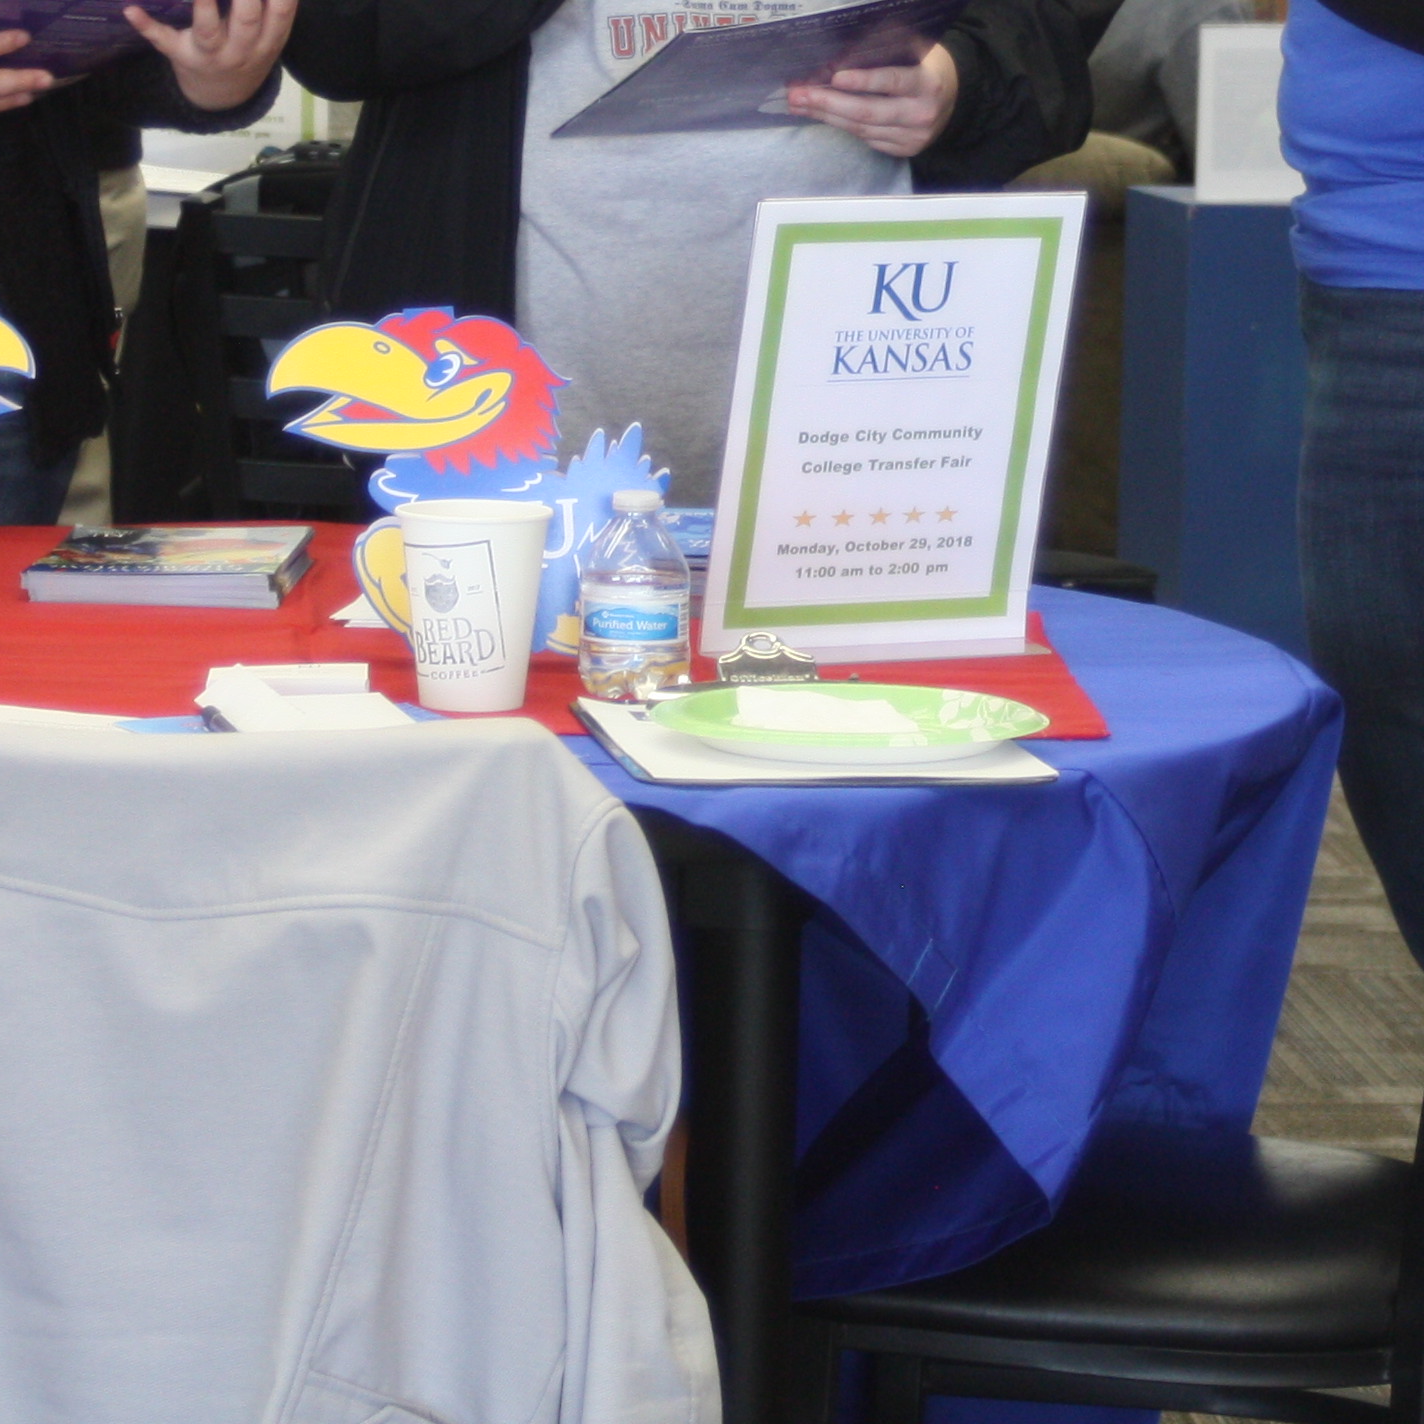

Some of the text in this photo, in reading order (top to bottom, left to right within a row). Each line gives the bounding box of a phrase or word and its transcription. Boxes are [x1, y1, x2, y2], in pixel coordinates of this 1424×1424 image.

[867, 261, 959, 322] KU
[835, 326, 975, 342] THE UNIVERSITY OF
[830, 341, 974, 375] KANSAS
[798, 426, 983, 446] Dodge City Community
[801, 455, 973, 476] College Transfer Fair
[777, 536, 973, 557] Monday, October 29, 2018
[795, 562, 949, 579] 11:00 am to 2:00 pm
[422, 617, 473, 644] RED
[592, 617, 668, 631] Purified Water
[415, 629, 496, 666] BEARD
[430, 670, 480, 680] COFFEE
